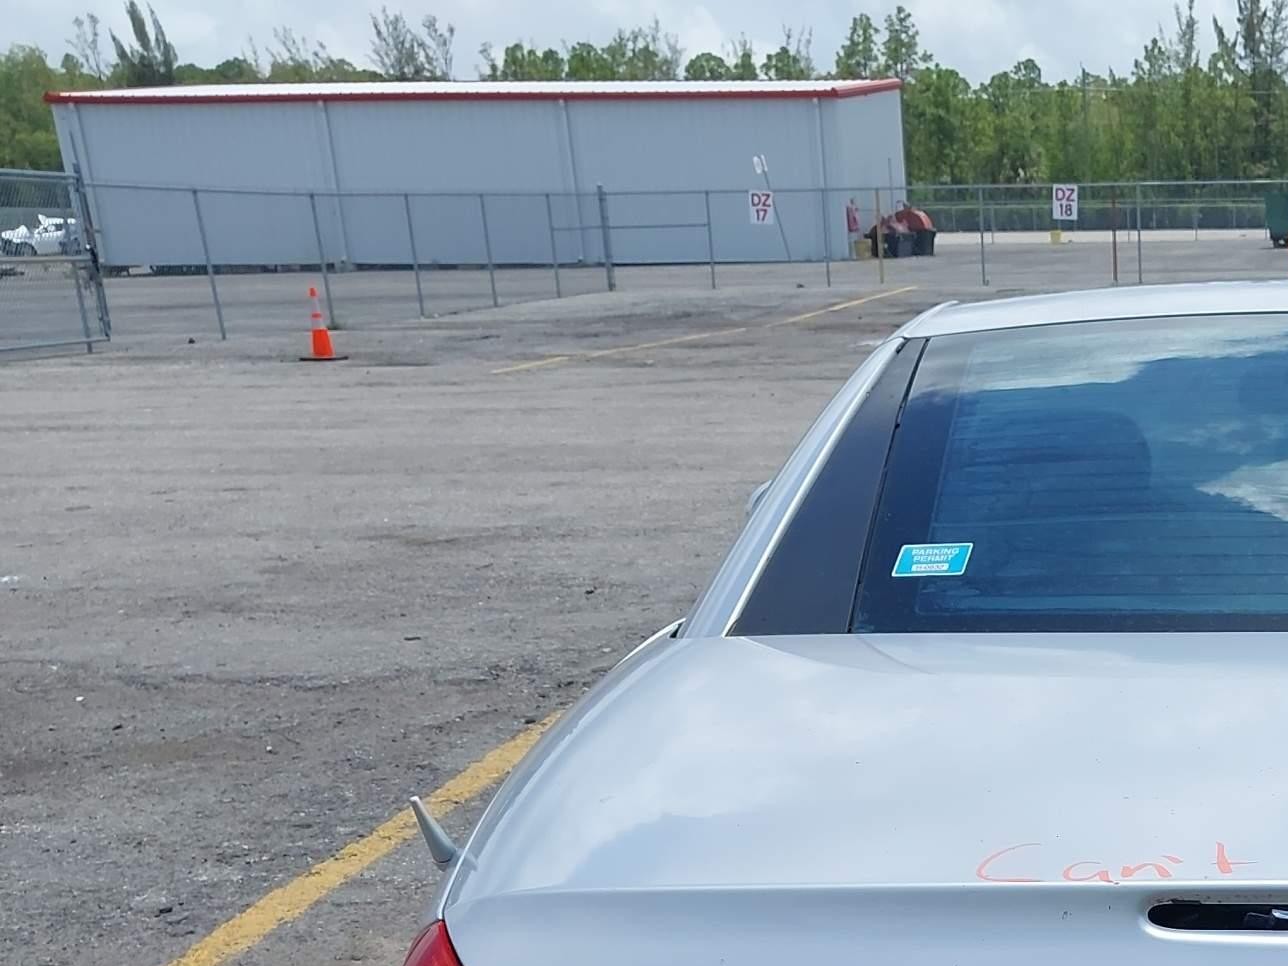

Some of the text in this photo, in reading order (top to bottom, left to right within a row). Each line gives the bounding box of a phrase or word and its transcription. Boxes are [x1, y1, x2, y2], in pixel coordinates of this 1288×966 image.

[751, 192, 771, 207] DZ
[1055, 187, 1075, 202] DZ
[756, 208, 768, 222] 17
[1059, 203, 1073, 217] 18
[911, 547, 960, 556] PARKING
[912, 555, 954, 563] PERMIT
